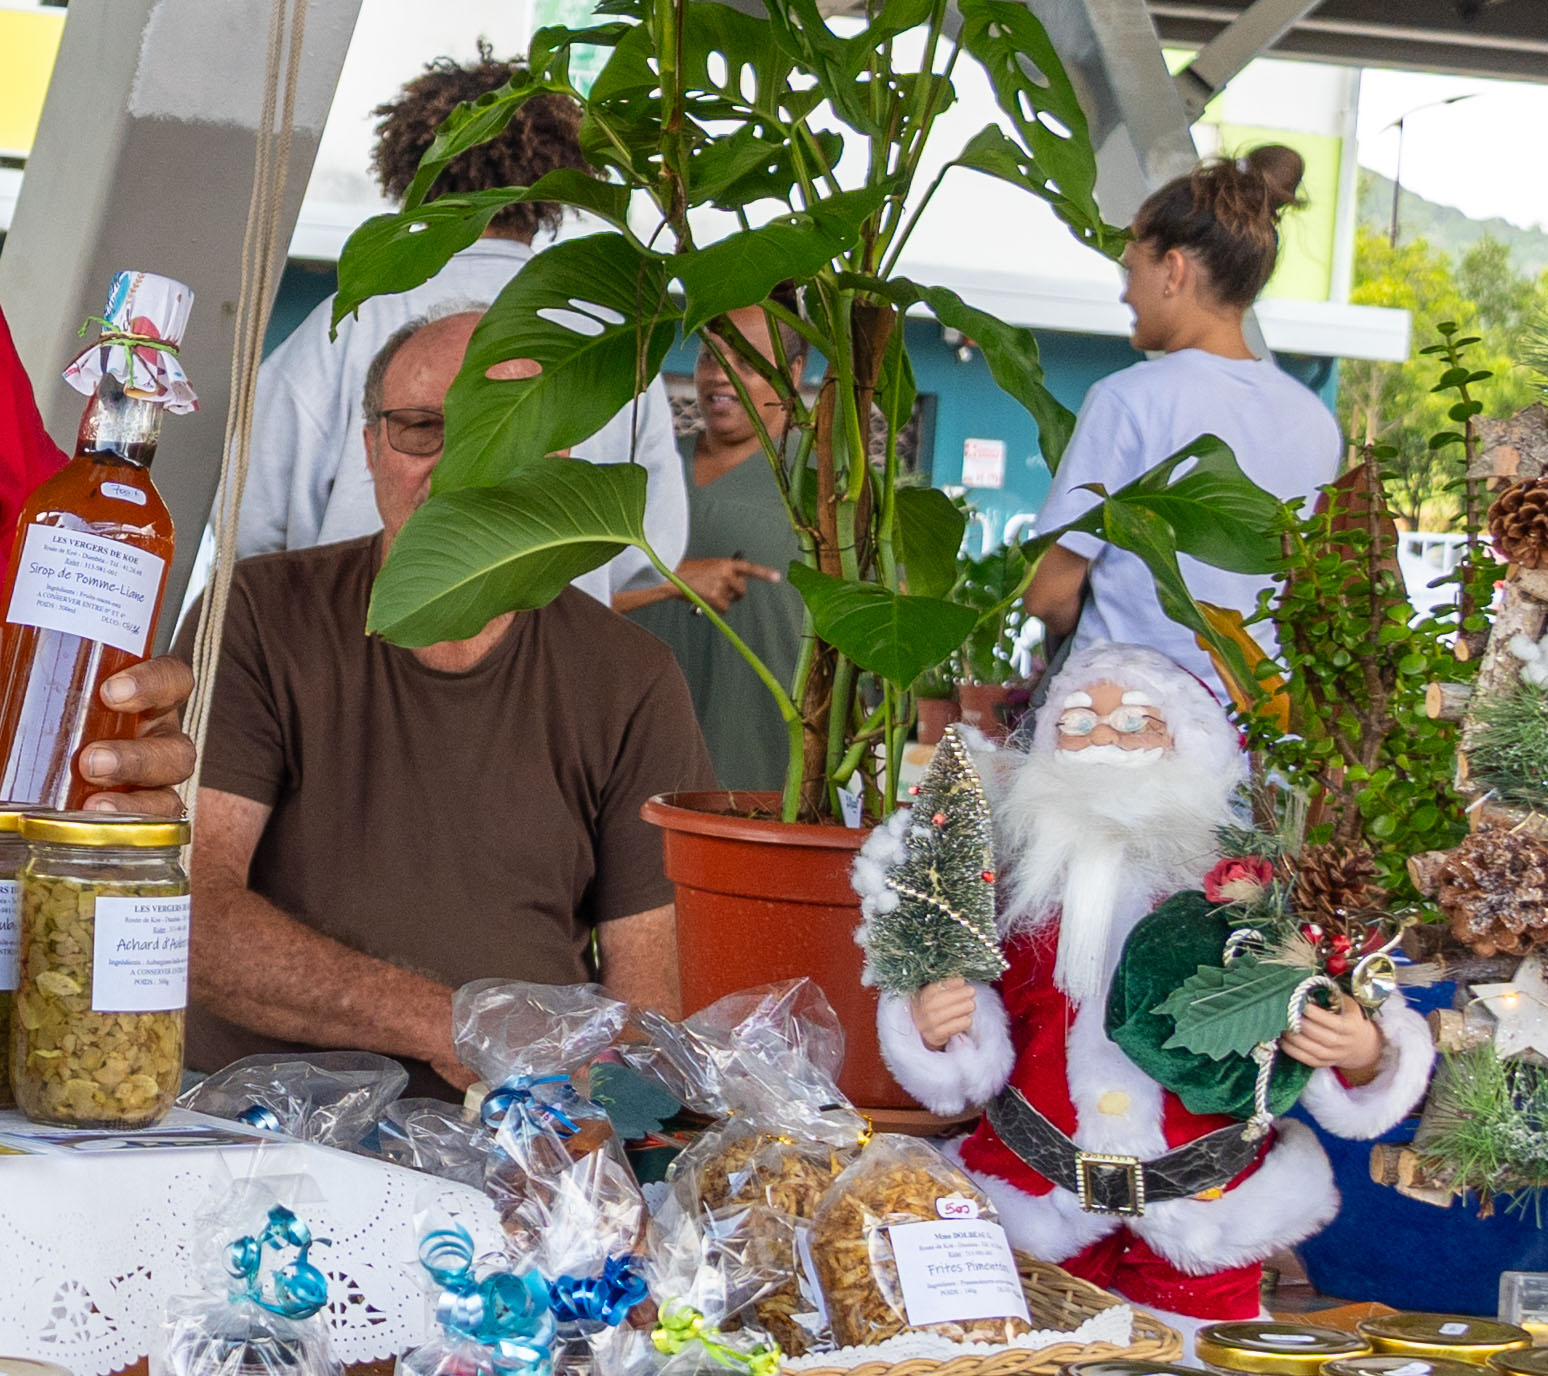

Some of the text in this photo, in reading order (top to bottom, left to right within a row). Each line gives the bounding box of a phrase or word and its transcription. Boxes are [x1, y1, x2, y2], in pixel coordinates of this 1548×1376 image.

[52, 535, 139, 565] LES VERGERS DE KOE
[29, 561, 145, 603] Sirop de Pomme-Liane
[116, 937, 159, 951] Achard
[927, 1263, 963, 1276] Frites
